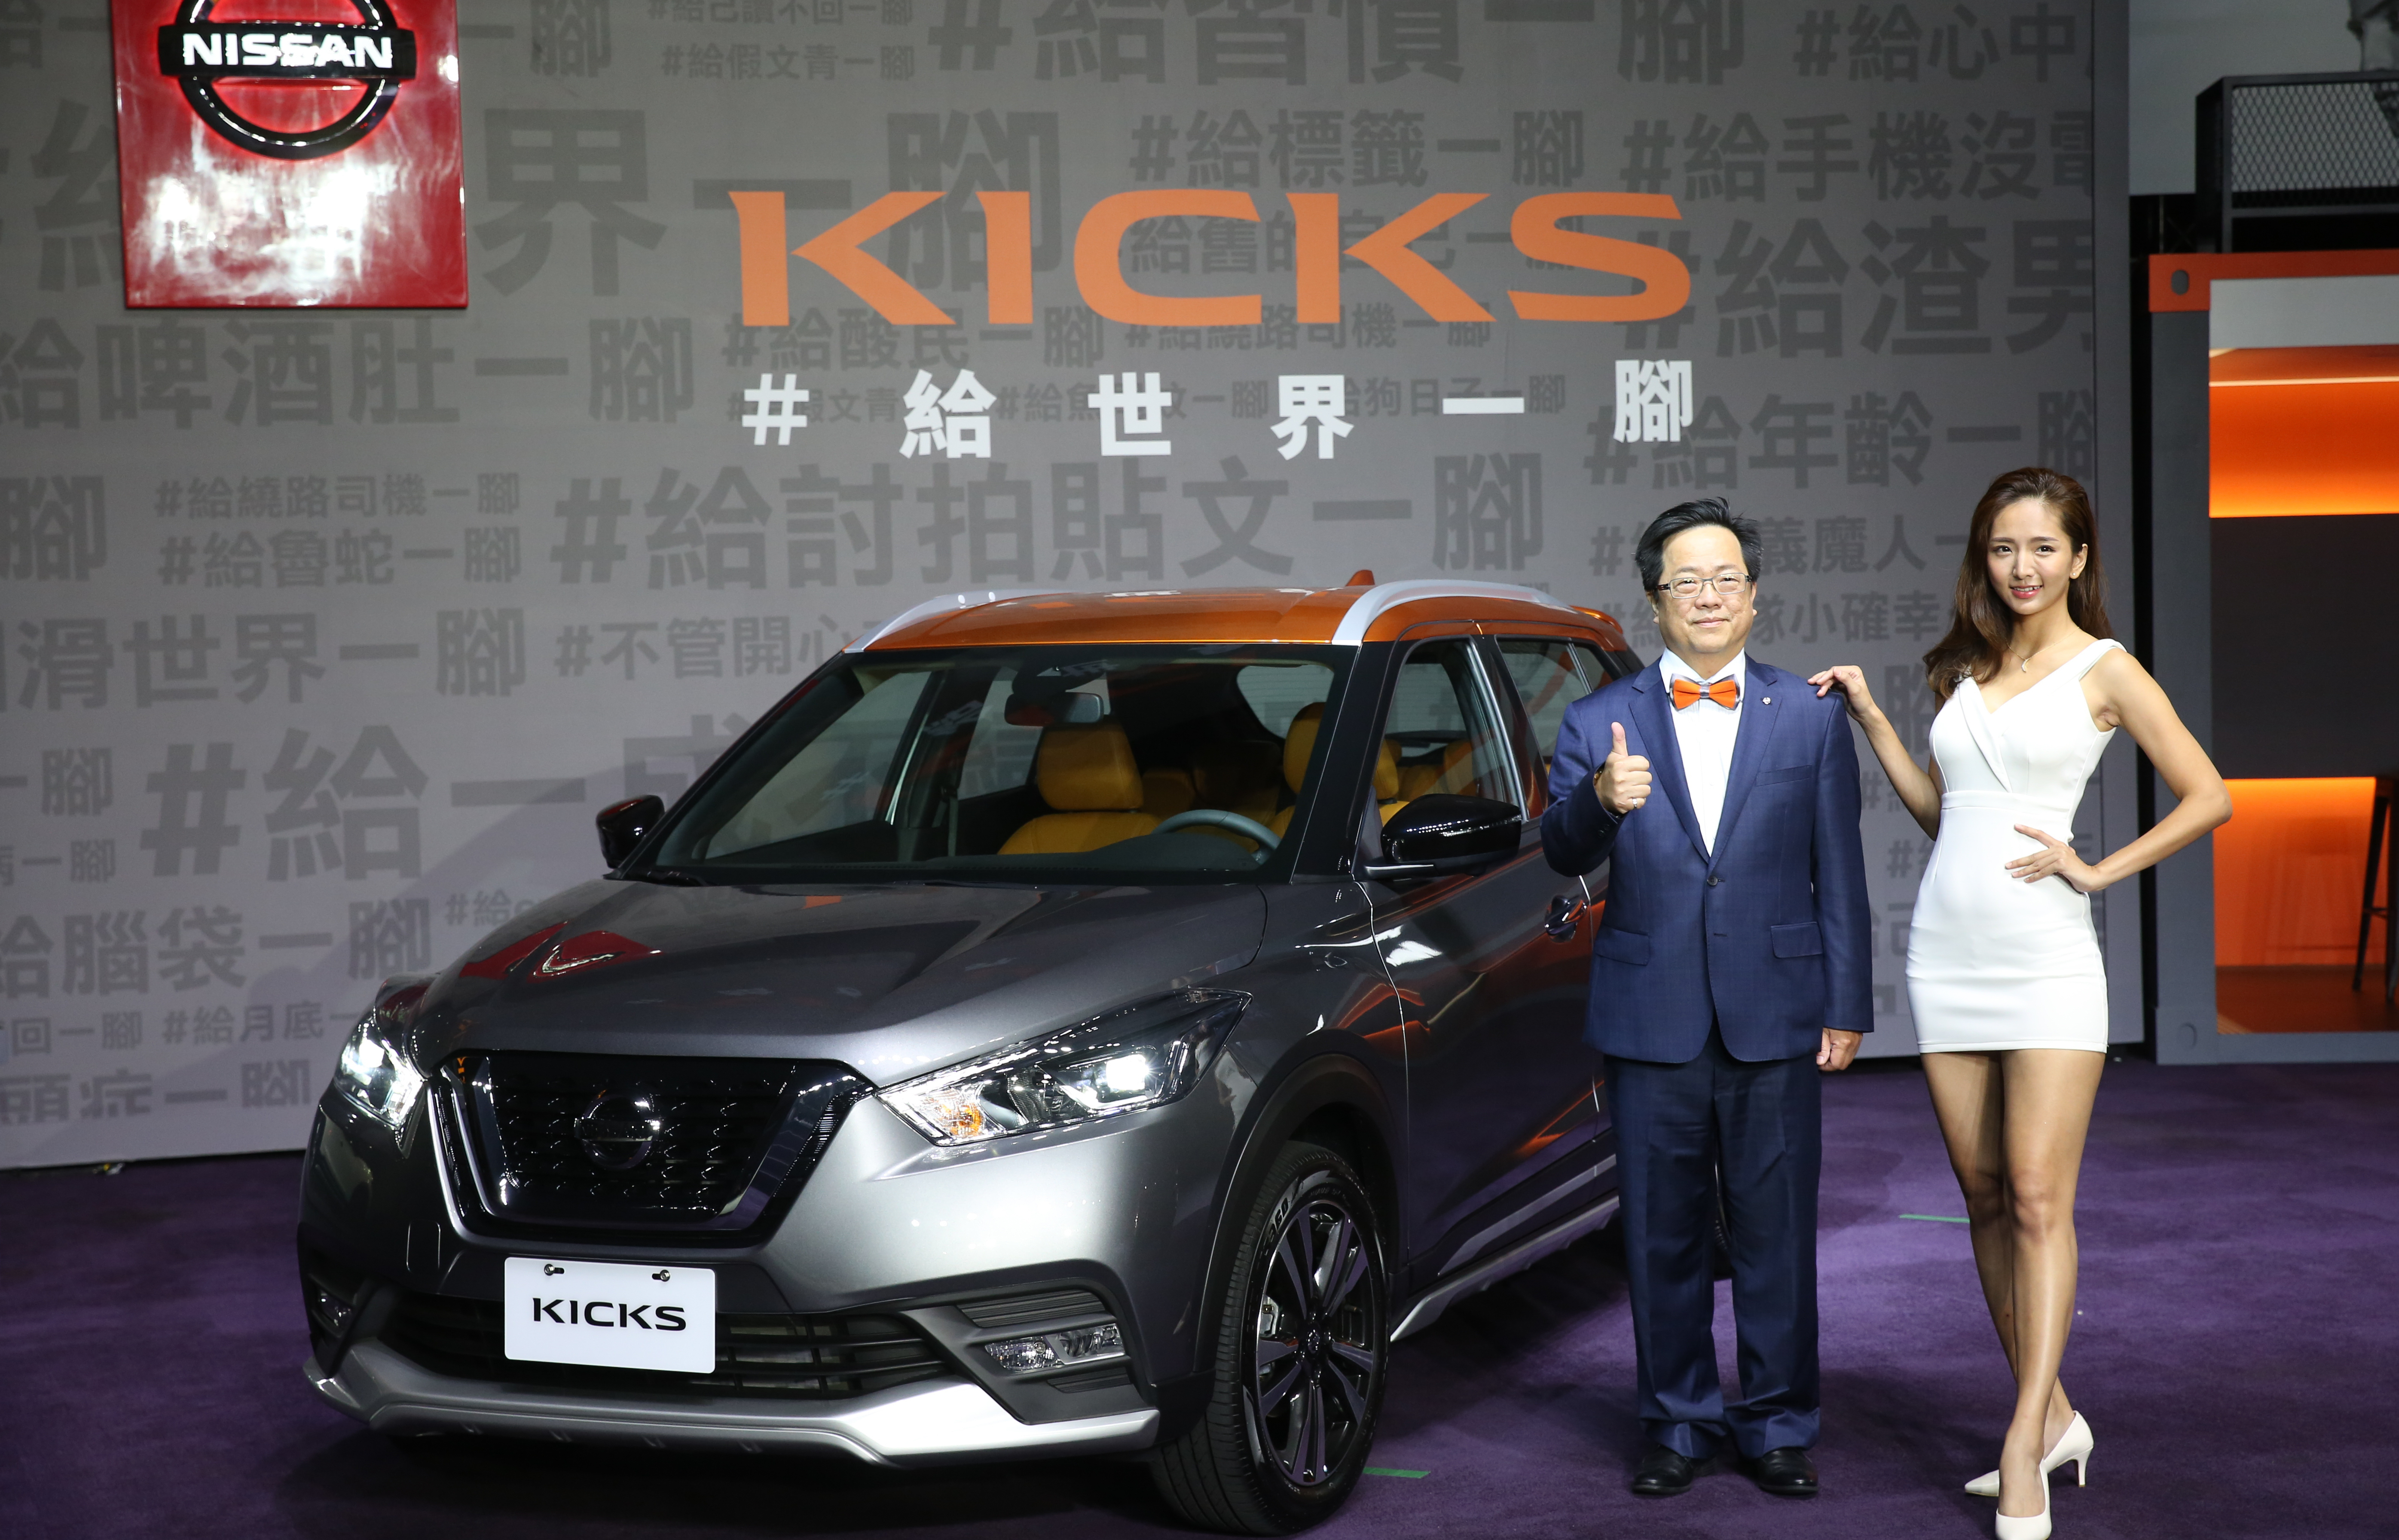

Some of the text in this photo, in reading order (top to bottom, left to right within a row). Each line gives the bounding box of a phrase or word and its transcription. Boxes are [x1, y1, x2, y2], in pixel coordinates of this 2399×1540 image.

[183, 32, 393, 69] NISSAN
[661, 43, 915, 81] #給假文青一腳
[1793, 2, 2093, 82] #給心中
[1128, 107, 1585, 189] #給標籤一腳
[727, 188, 1692, 327] KICKS
[154, 473, 520, 518] #給繞路司機一腳
[550, 454, 1544, 590] #給討拍貼文一腳
[157, 526, 522, 589] #給魯蛇一腳
[0, 607, 527, 711] 滑世界一腳
[533, 1297, 687, 1331] KICKS
